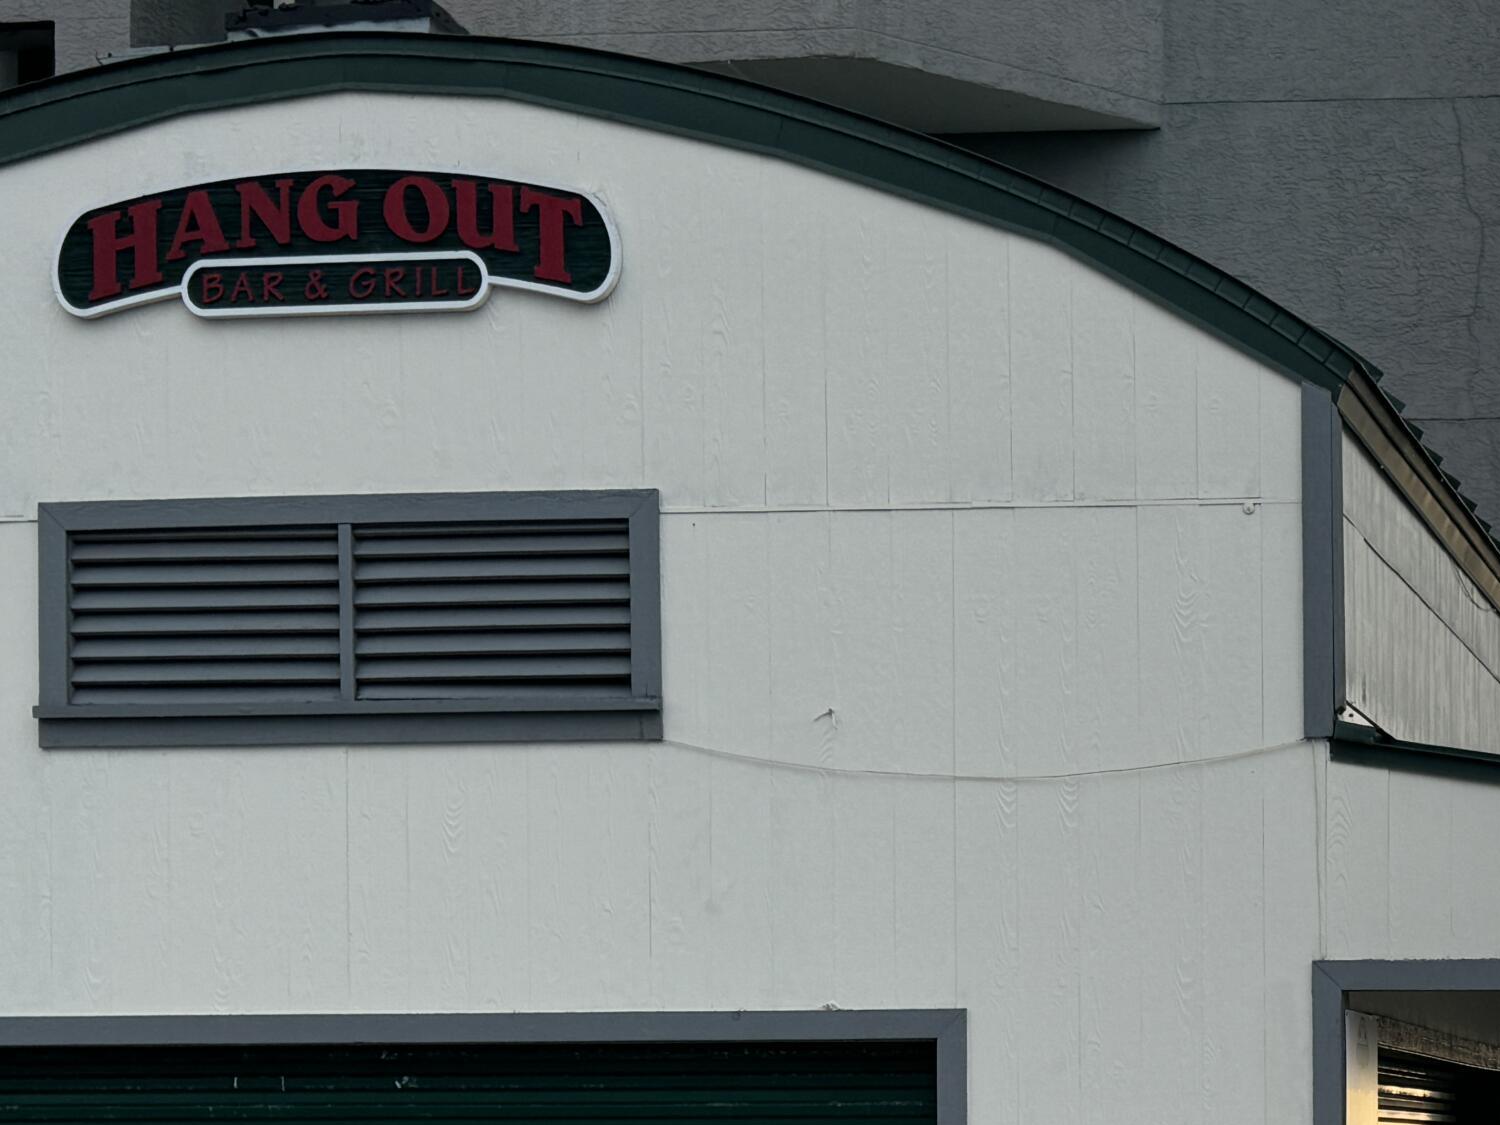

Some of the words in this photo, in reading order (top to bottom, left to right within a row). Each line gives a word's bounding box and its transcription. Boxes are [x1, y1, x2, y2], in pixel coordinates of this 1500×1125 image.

[88, 174, 358, 300] HANG
[383, 175, 583, 283] OUT
[202, 269, 284, 304] BAR
[305, 269, 329, 300] &
[348, 264, 476, 298] GRILL
